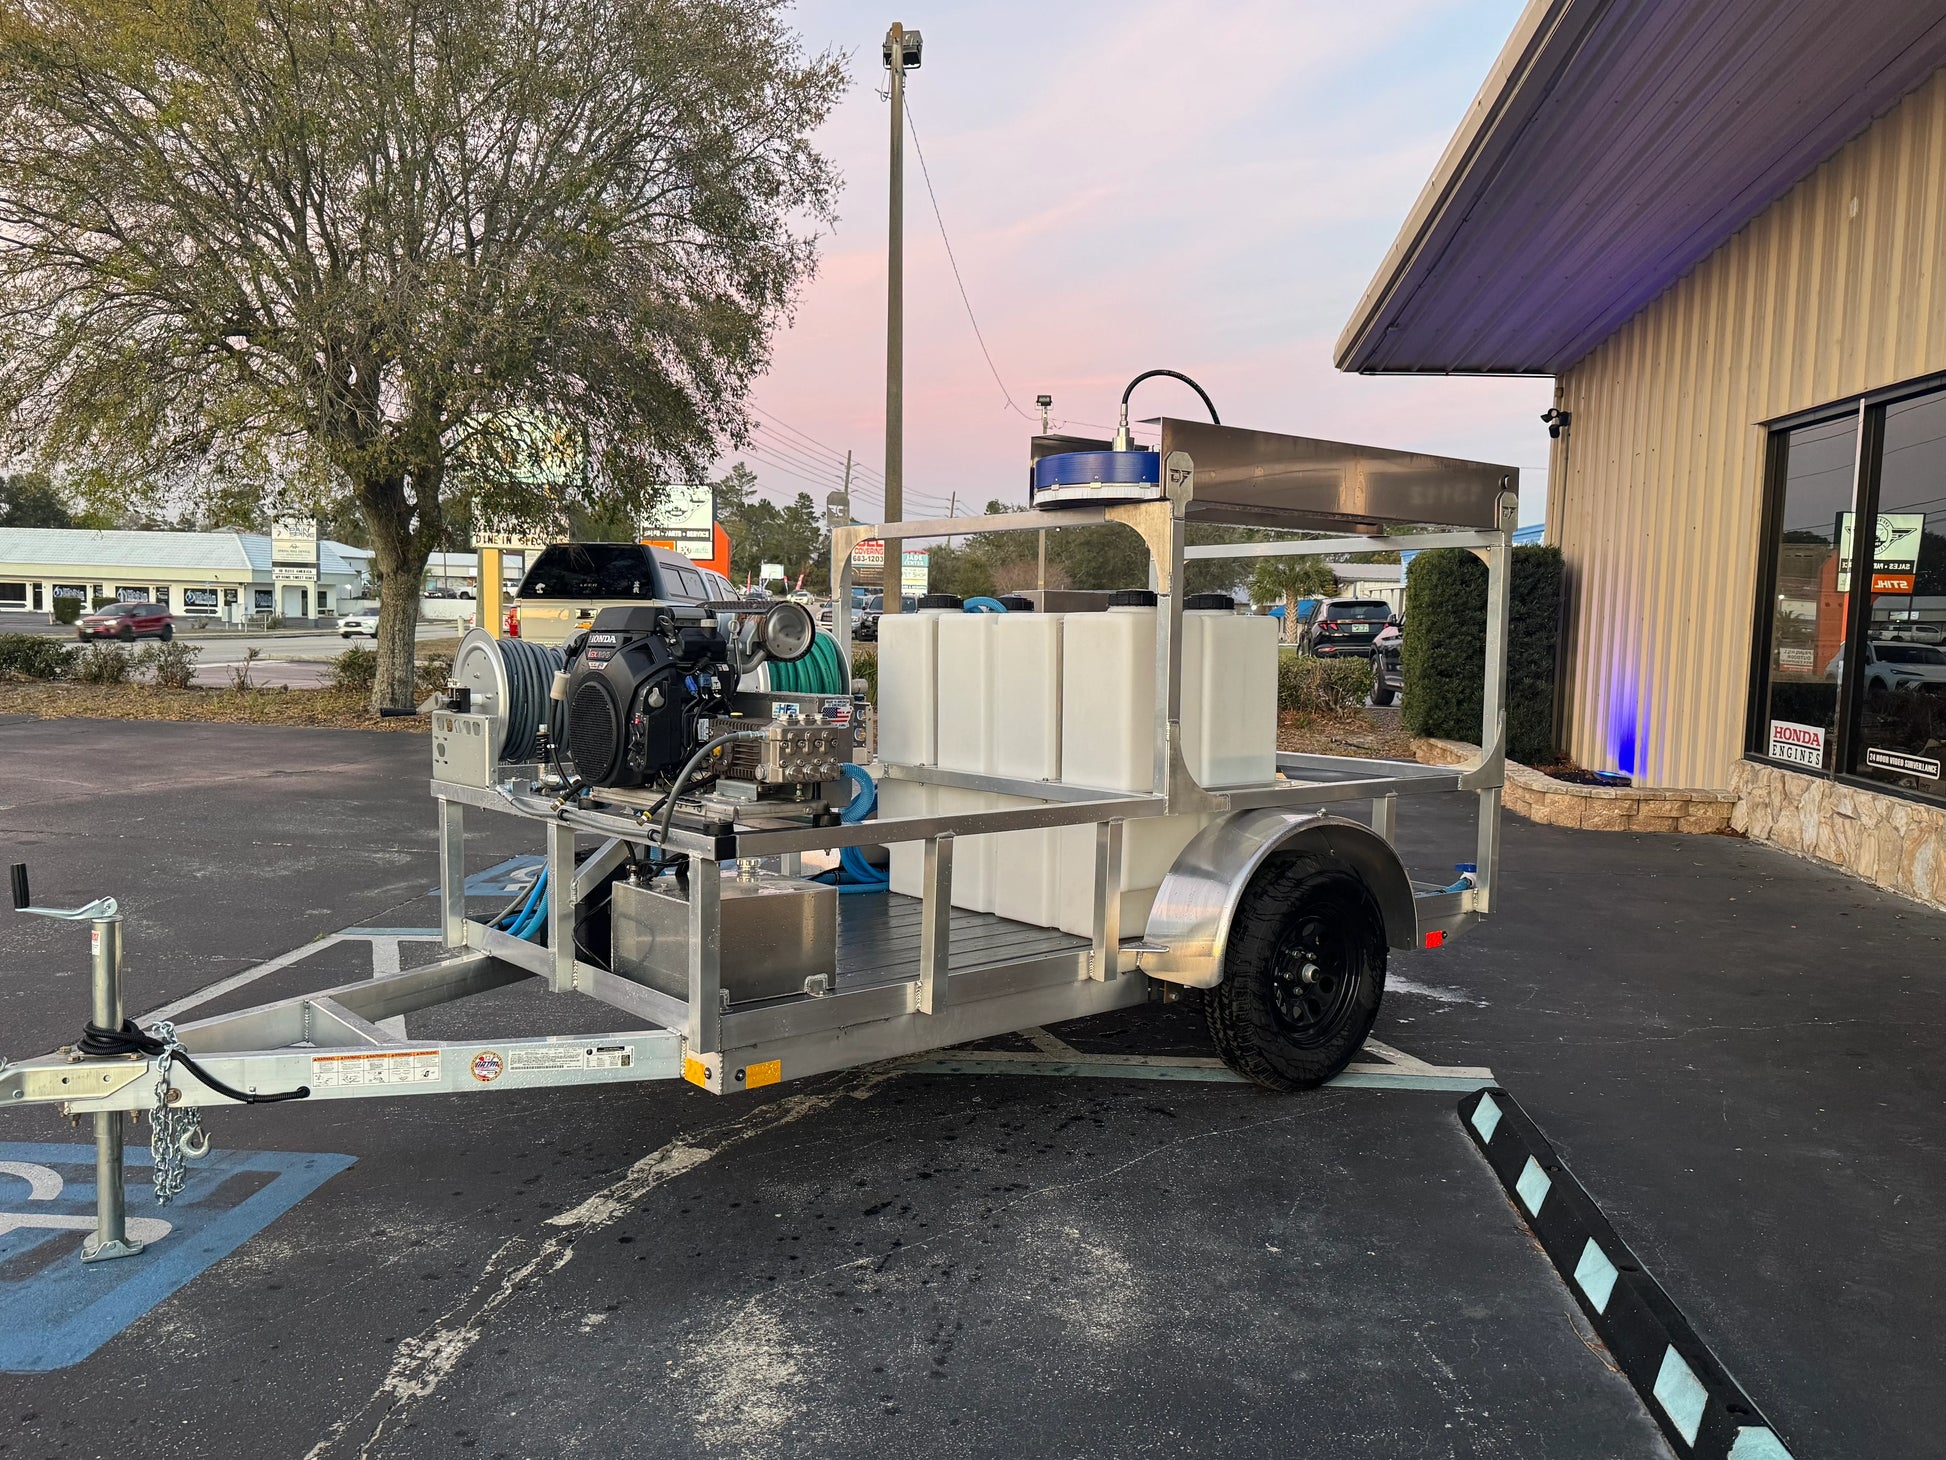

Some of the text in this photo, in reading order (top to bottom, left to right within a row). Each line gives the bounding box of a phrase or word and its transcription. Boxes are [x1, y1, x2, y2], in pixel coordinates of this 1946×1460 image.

[501, 535, 512, 545] IN
[686, 530, 710, 538] SERVICE
[1773, 725, 1821, 747] HONDA
[1772, 744, 1820, 766] ENGINES
[1869, 752, 1876, 761] 24
[1904, 759, 1938, 775] SURVEILLANCE
